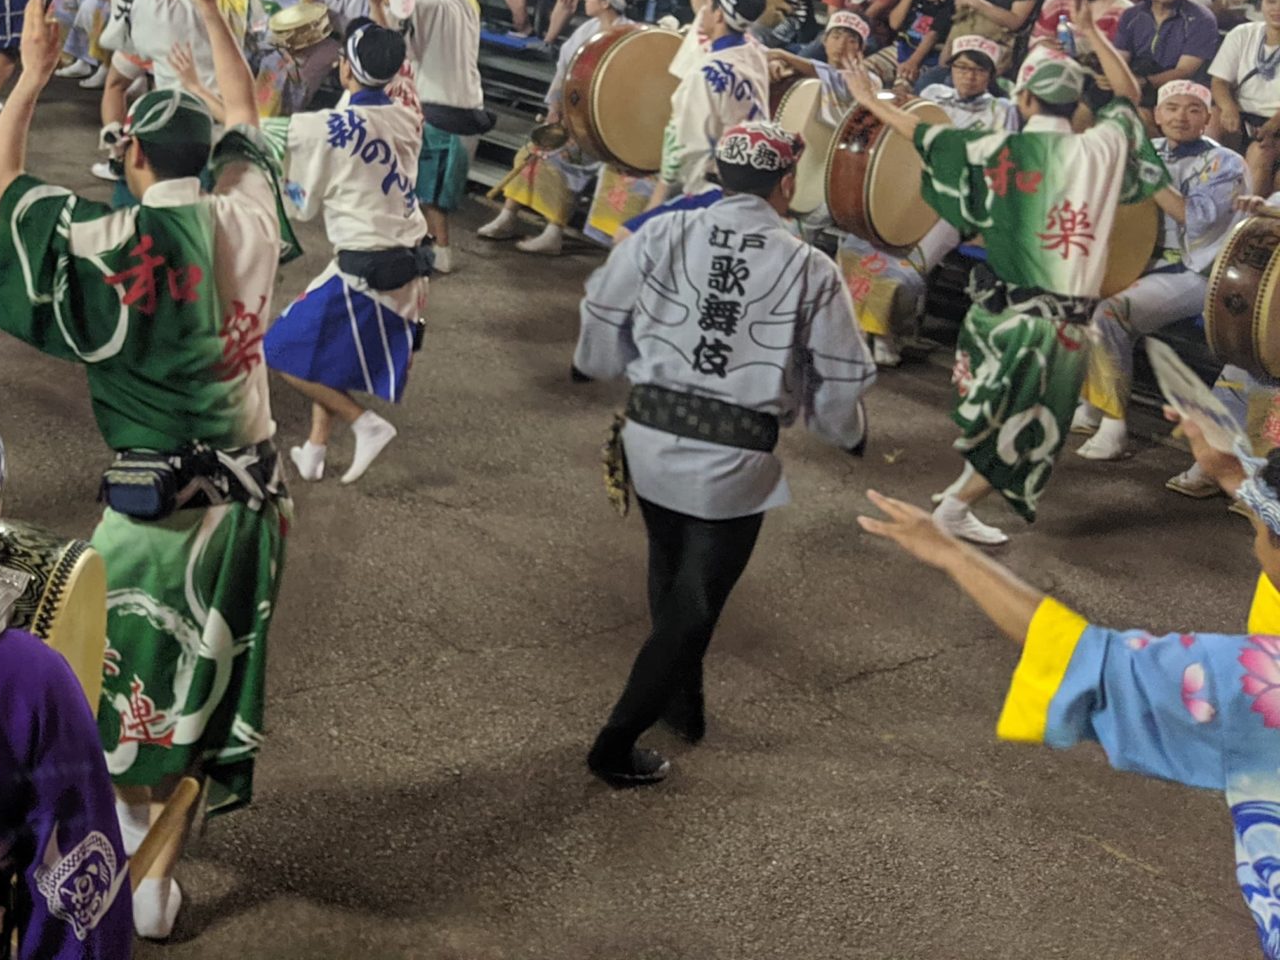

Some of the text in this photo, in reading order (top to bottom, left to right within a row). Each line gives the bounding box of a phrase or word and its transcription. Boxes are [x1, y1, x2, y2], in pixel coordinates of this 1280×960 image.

[708, 225, 767, 252] 江戸
[692, 255, 750, 378] 歌舞伎
